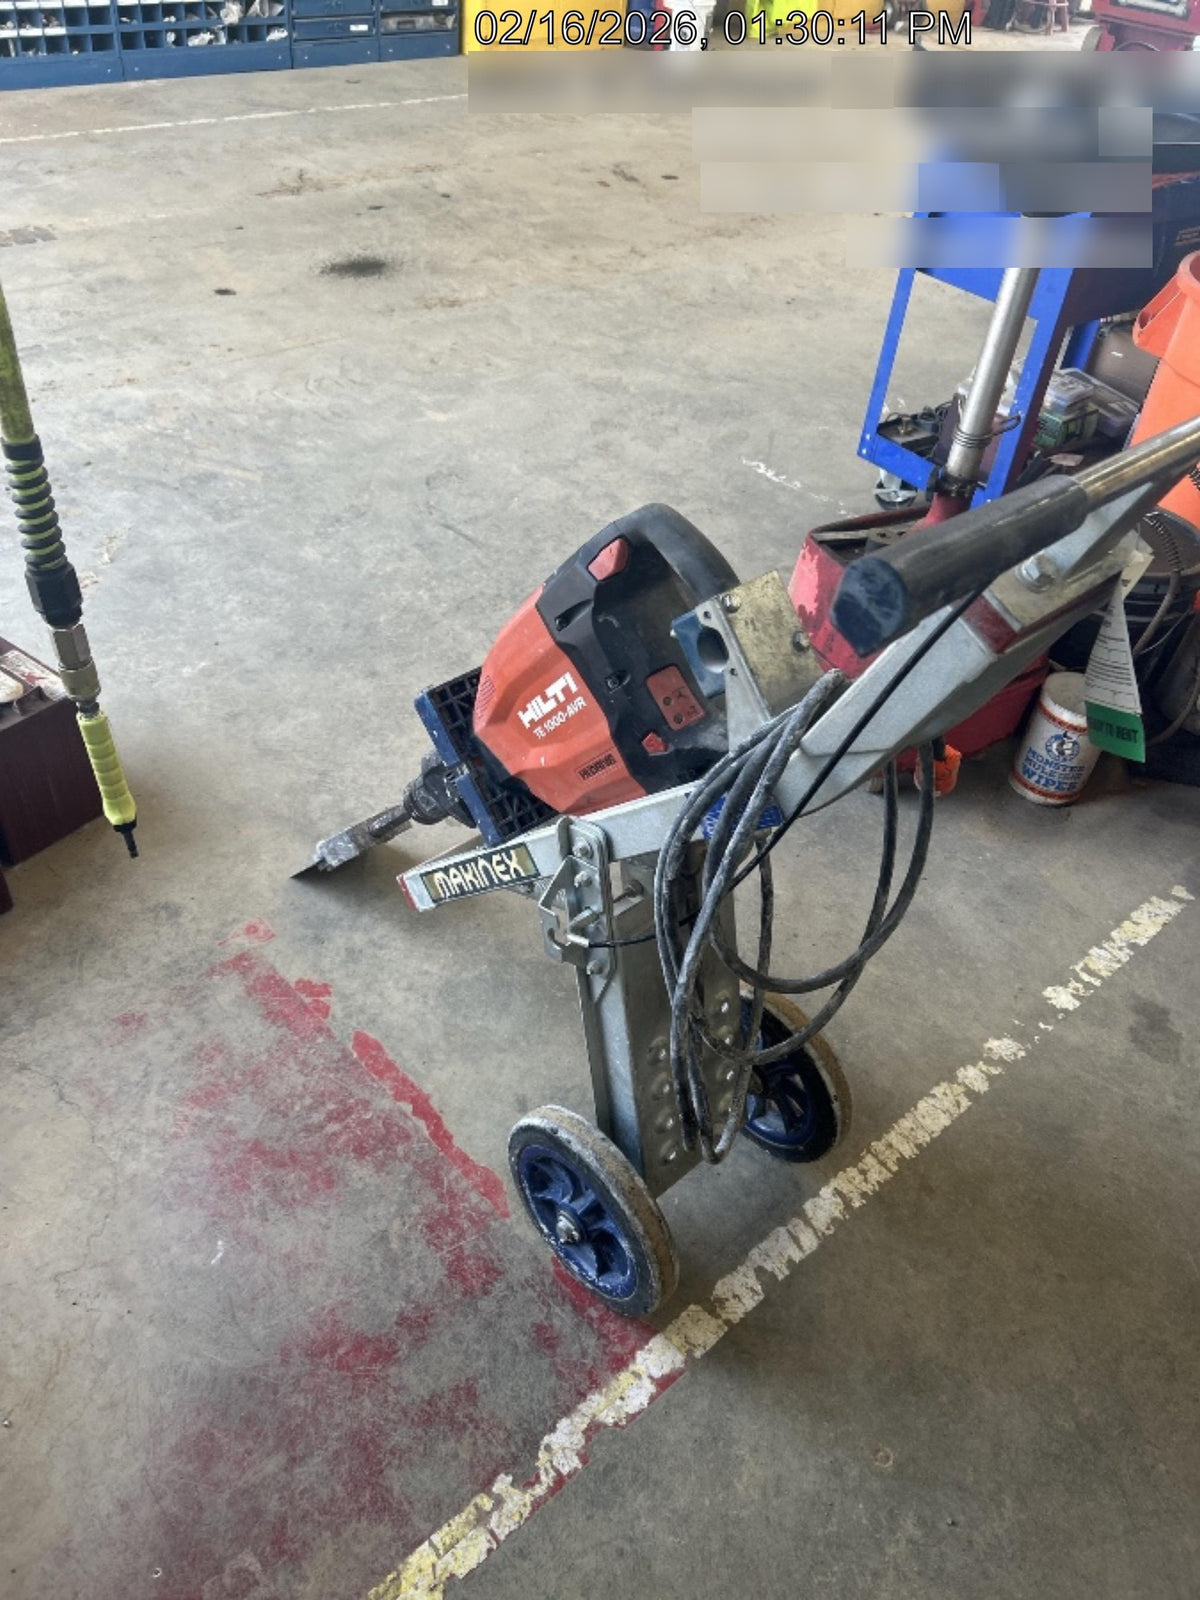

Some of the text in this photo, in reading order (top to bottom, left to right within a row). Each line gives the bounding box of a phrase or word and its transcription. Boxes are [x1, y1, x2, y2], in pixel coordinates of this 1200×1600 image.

[517, 671, 578, 729] HILTI
[533, 696, 587, 739] TE 1000-AVR
[1022, 765, 1078, 791] WIPES
[433, 849, 526, 899] MAKINEX
